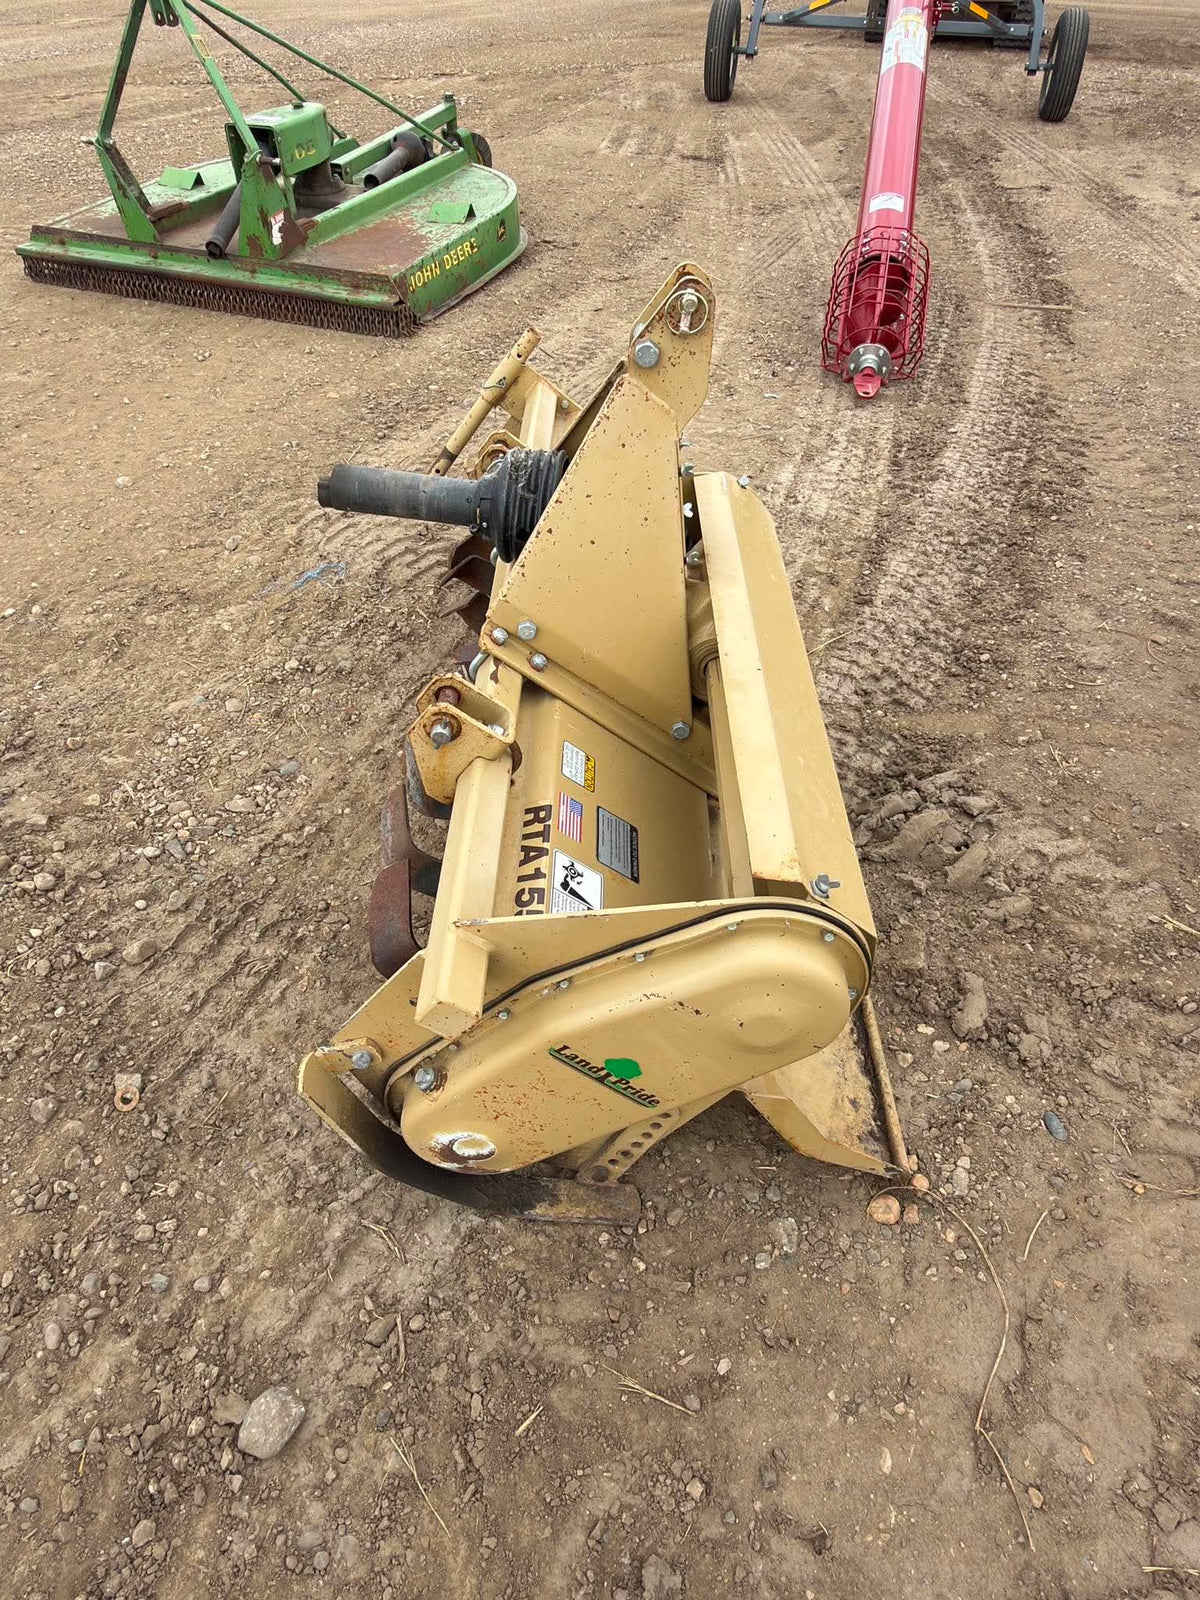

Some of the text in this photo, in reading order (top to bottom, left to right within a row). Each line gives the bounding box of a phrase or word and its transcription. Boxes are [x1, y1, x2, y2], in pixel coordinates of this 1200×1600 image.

[409, 237, 480, 291] JOHN DEERE
[514, 804, 553, 917] RTA15
[553, 1044, 661, 1106] Land Pride
